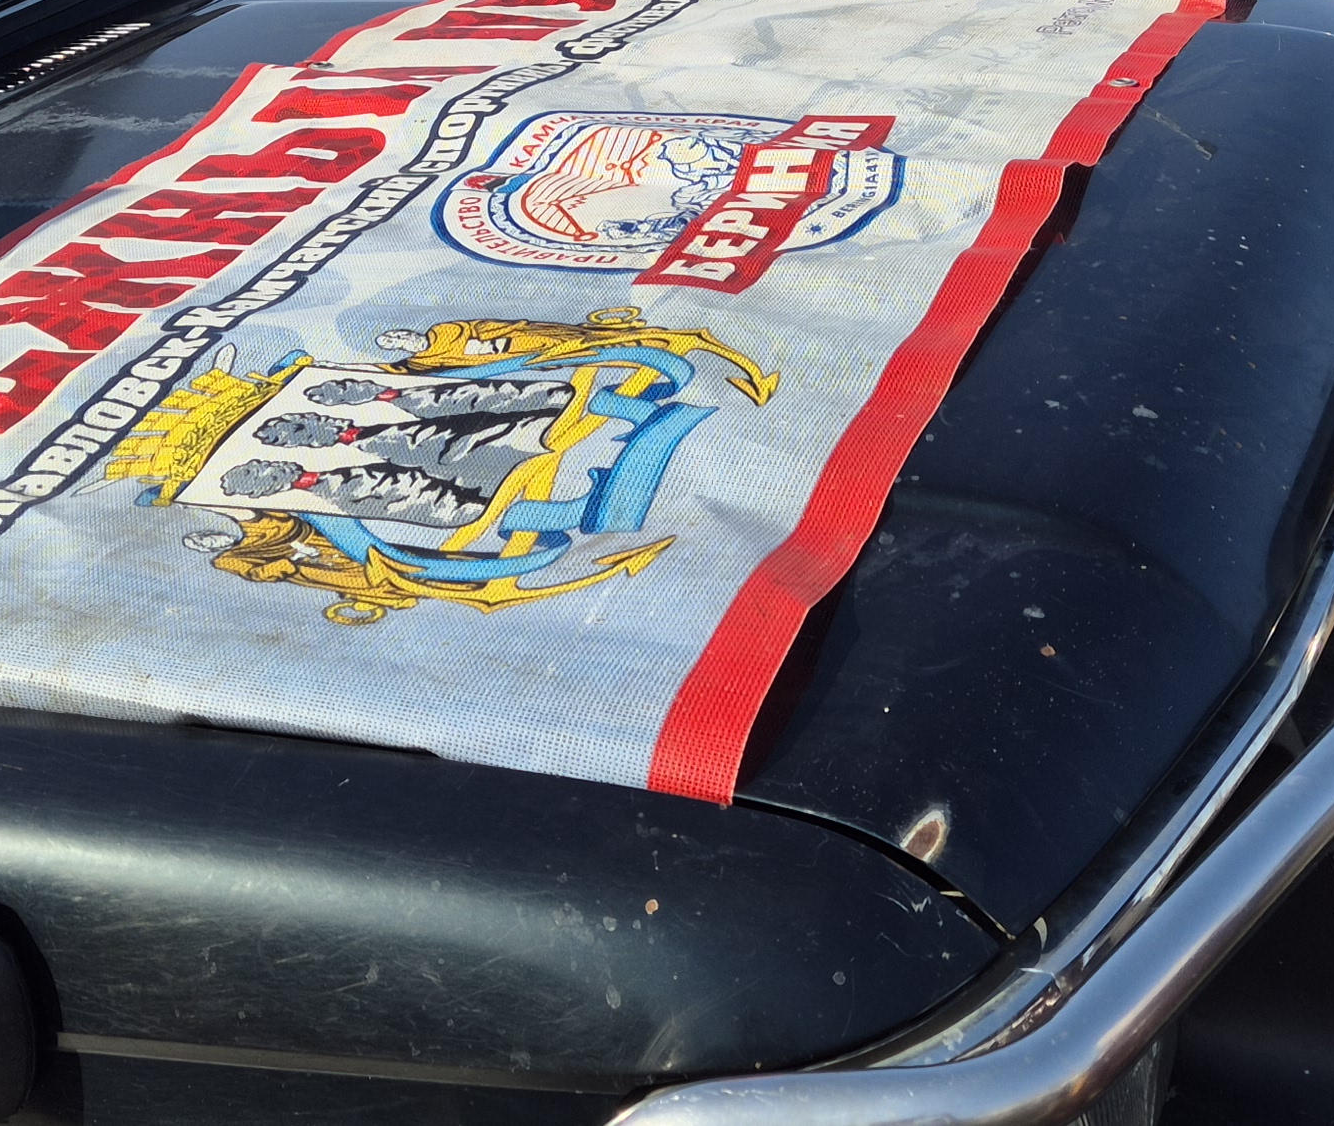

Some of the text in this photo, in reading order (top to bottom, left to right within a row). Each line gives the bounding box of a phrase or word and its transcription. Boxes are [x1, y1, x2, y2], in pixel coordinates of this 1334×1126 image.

[407, 60, 577, 174] спортивны
[508, 114, 689, 170] КАМЧАТСКОГО
[458, 194, 620, 266] ПРАВИТЕЛЬСТВО
